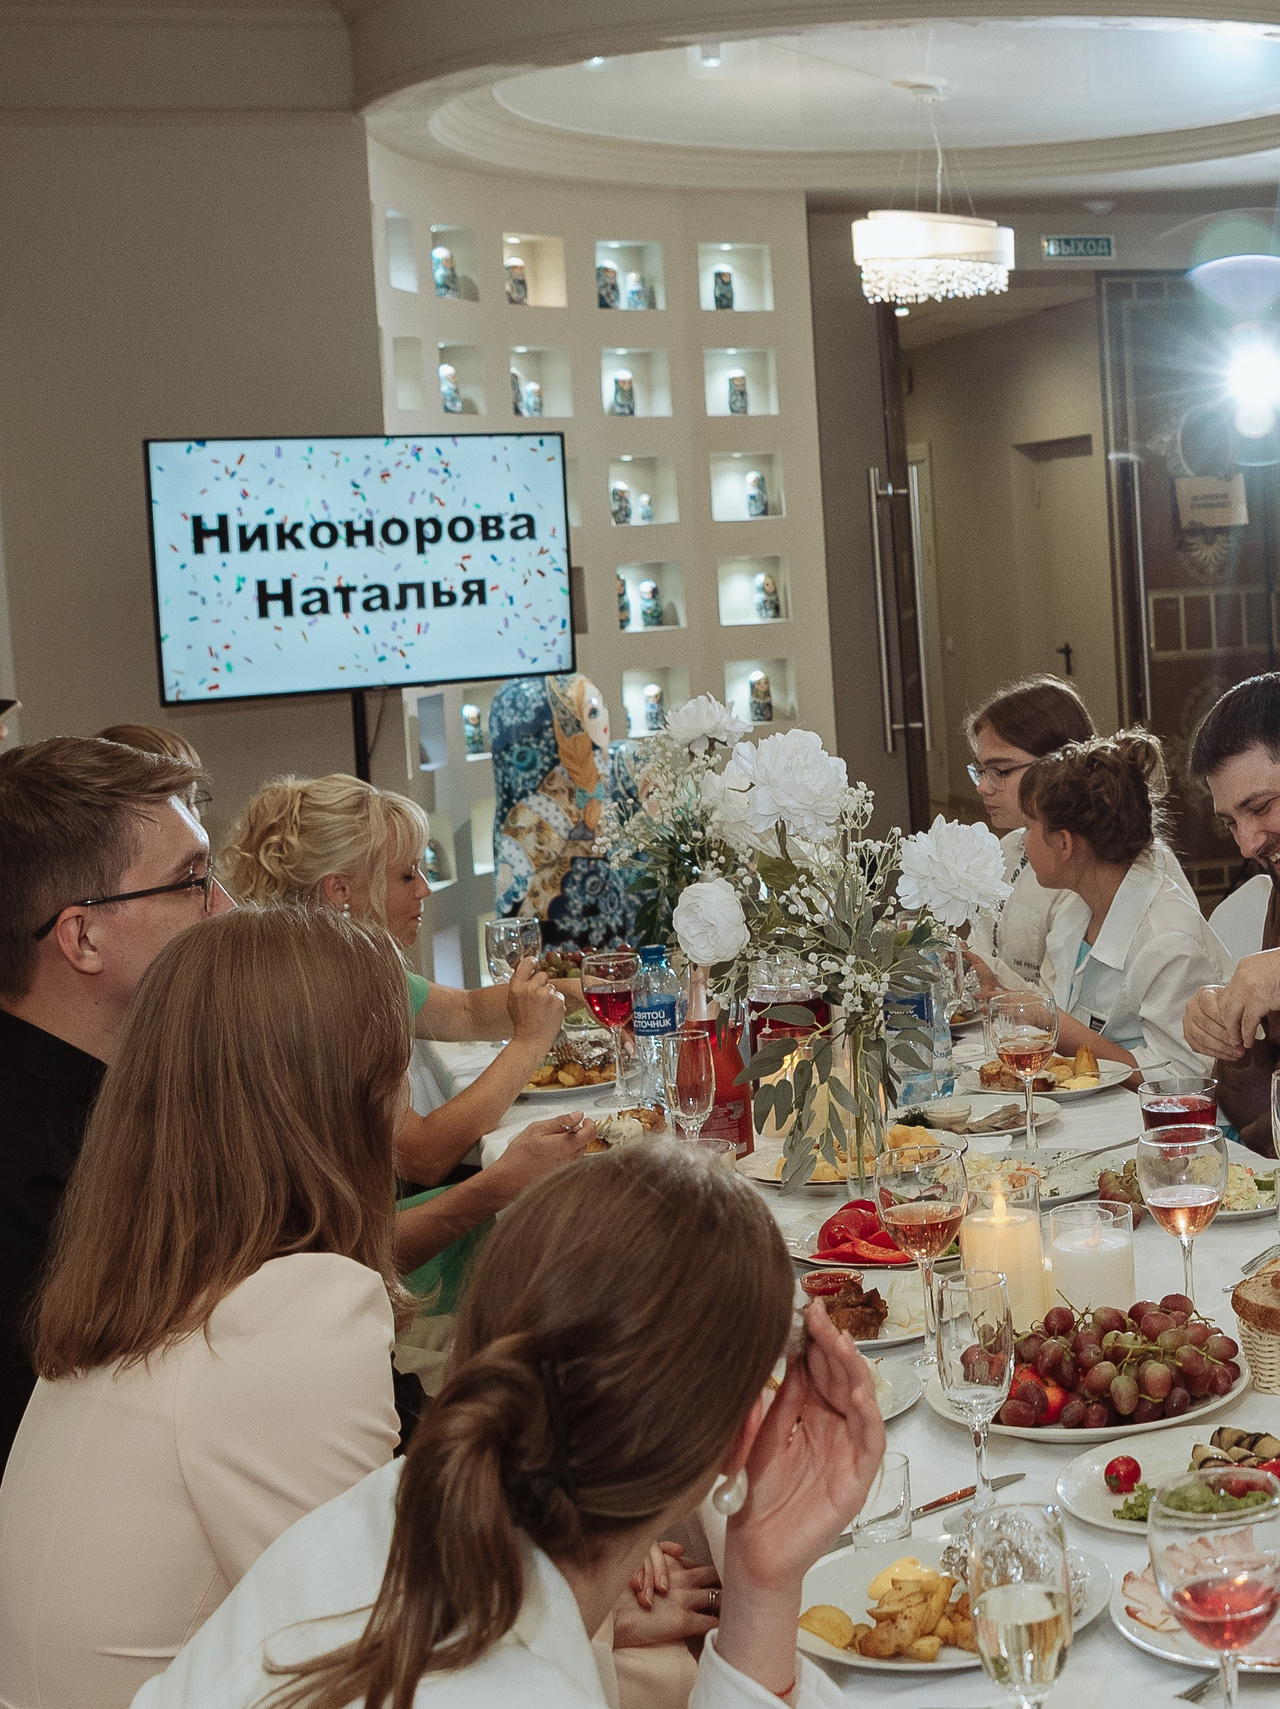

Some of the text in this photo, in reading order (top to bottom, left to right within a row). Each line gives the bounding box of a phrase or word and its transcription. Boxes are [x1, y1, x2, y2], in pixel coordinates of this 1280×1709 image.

[1050, 239, 1108, 255] ВЫХОД
[191, 511, 537, 555] Никонорова
[256, 577, 488, 619] Наталья
[633, 1009, 666, 1020] СВЯТОЙ
[633, 1018, 672, 1028] СТОЧНИК
